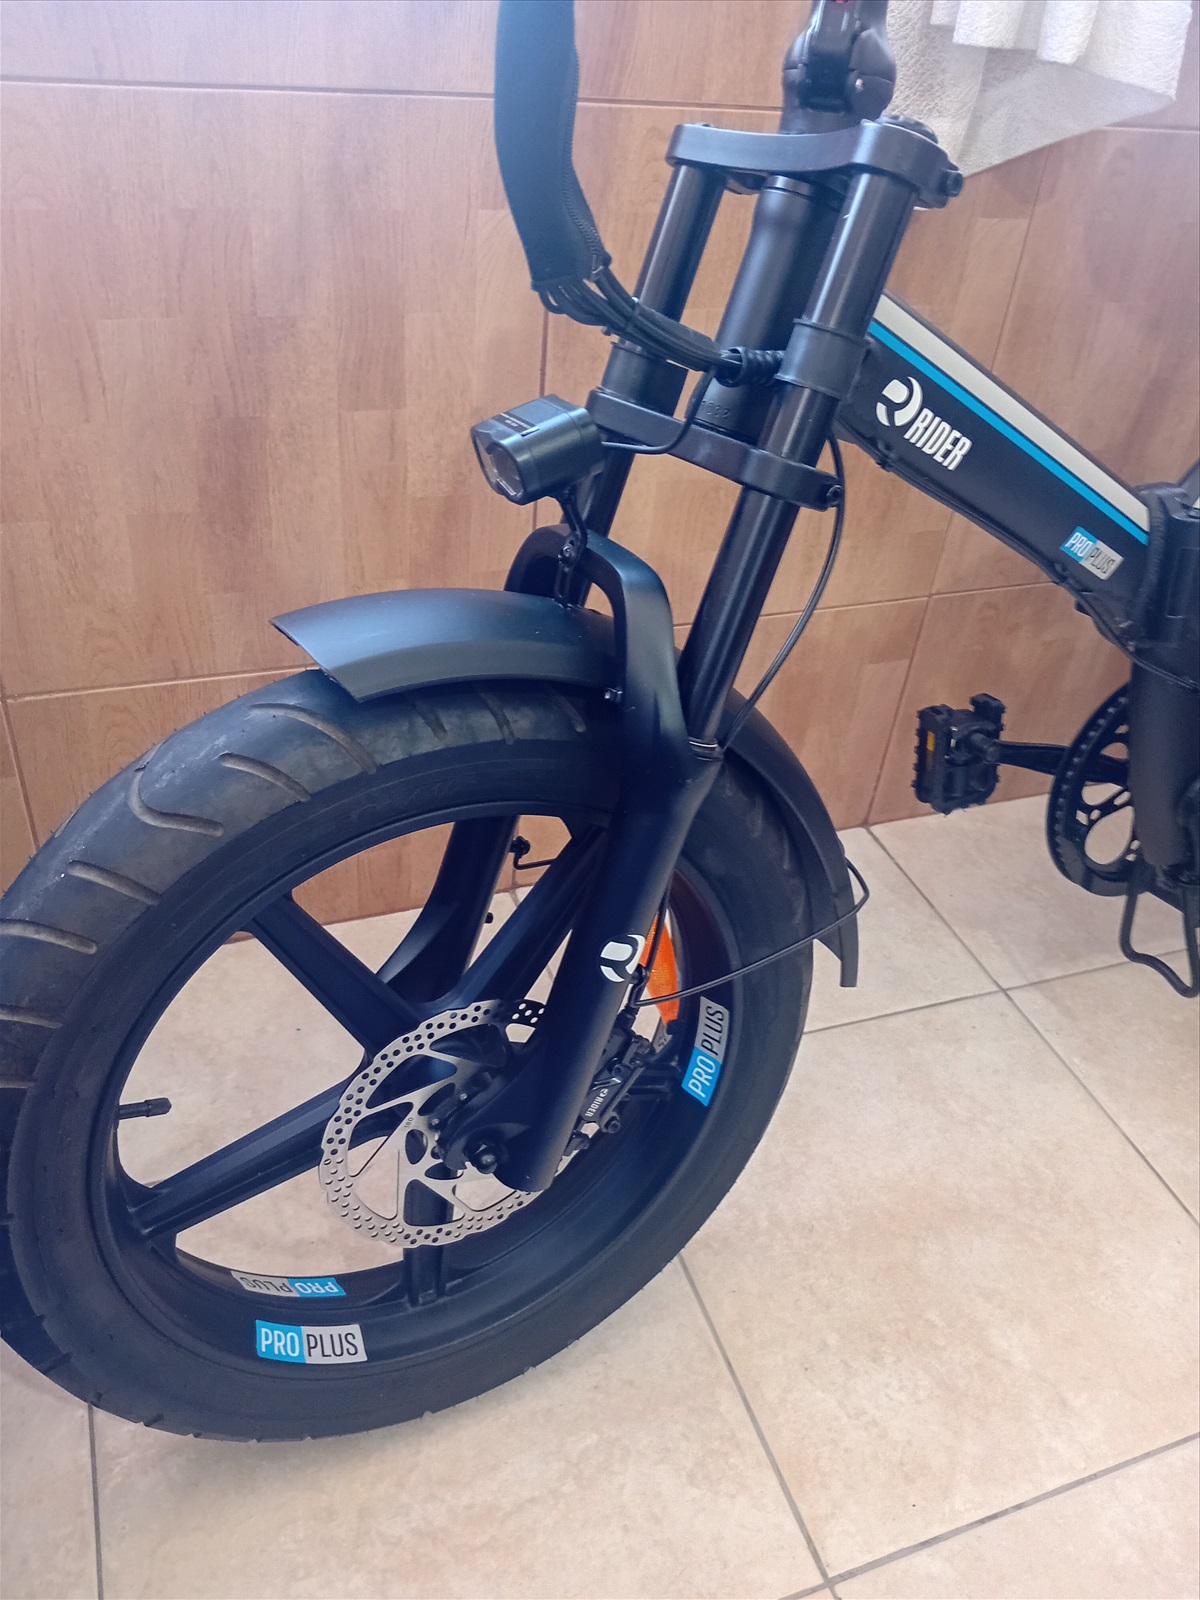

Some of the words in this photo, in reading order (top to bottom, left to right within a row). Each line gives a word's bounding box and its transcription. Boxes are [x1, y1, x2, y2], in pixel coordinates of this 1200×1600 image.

[903, 407, 973, 471] RIDER
[1064, 531, 1094, 557] PRO
[1085, 547, 1116, 574] PLUS
[700, 1005, 724, 1056] PLUS
[687, 1055, 716, 1098] PRO
[584, 1096, 604, 1117] RIDER
[239, 1276, 293, 1293] PLUS
[294, 1281, 339, 1294] PRO
[260, 1327, 300, 1357] PRO
[306, 1332, 359, 1358] PLUS
